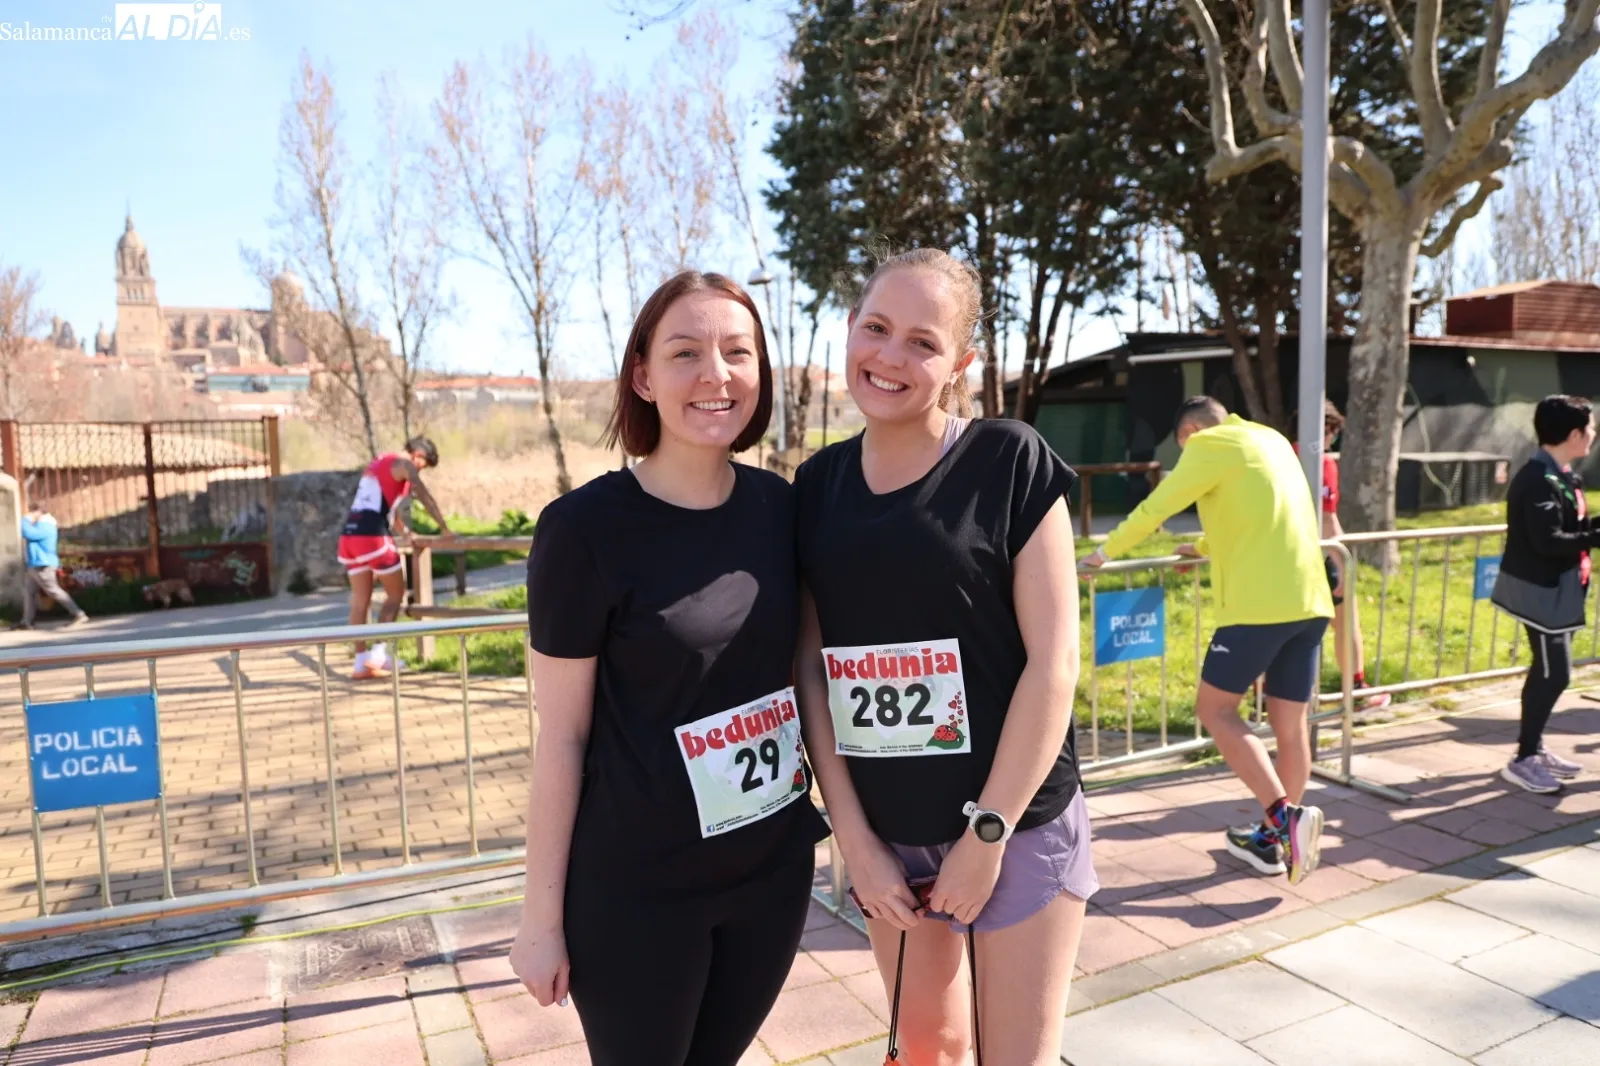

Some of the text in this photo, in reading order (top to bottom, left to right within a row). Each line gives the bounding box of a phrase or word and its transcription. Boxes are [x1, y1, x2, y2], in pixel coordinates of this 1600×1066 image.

[1110, 612, 1158, 632] POLICIA
[1113, 629, 1156, 648] LOCAL
[827, 648, 958, 680] bedunia
[850, 683, 934, 727] 282
[34, 725, 143, 754] POLICIA
[680, 699, 796, 760] bedunia
[42, 752, 138, 779] LOCAL
[735, 738, 780, 793] 29
